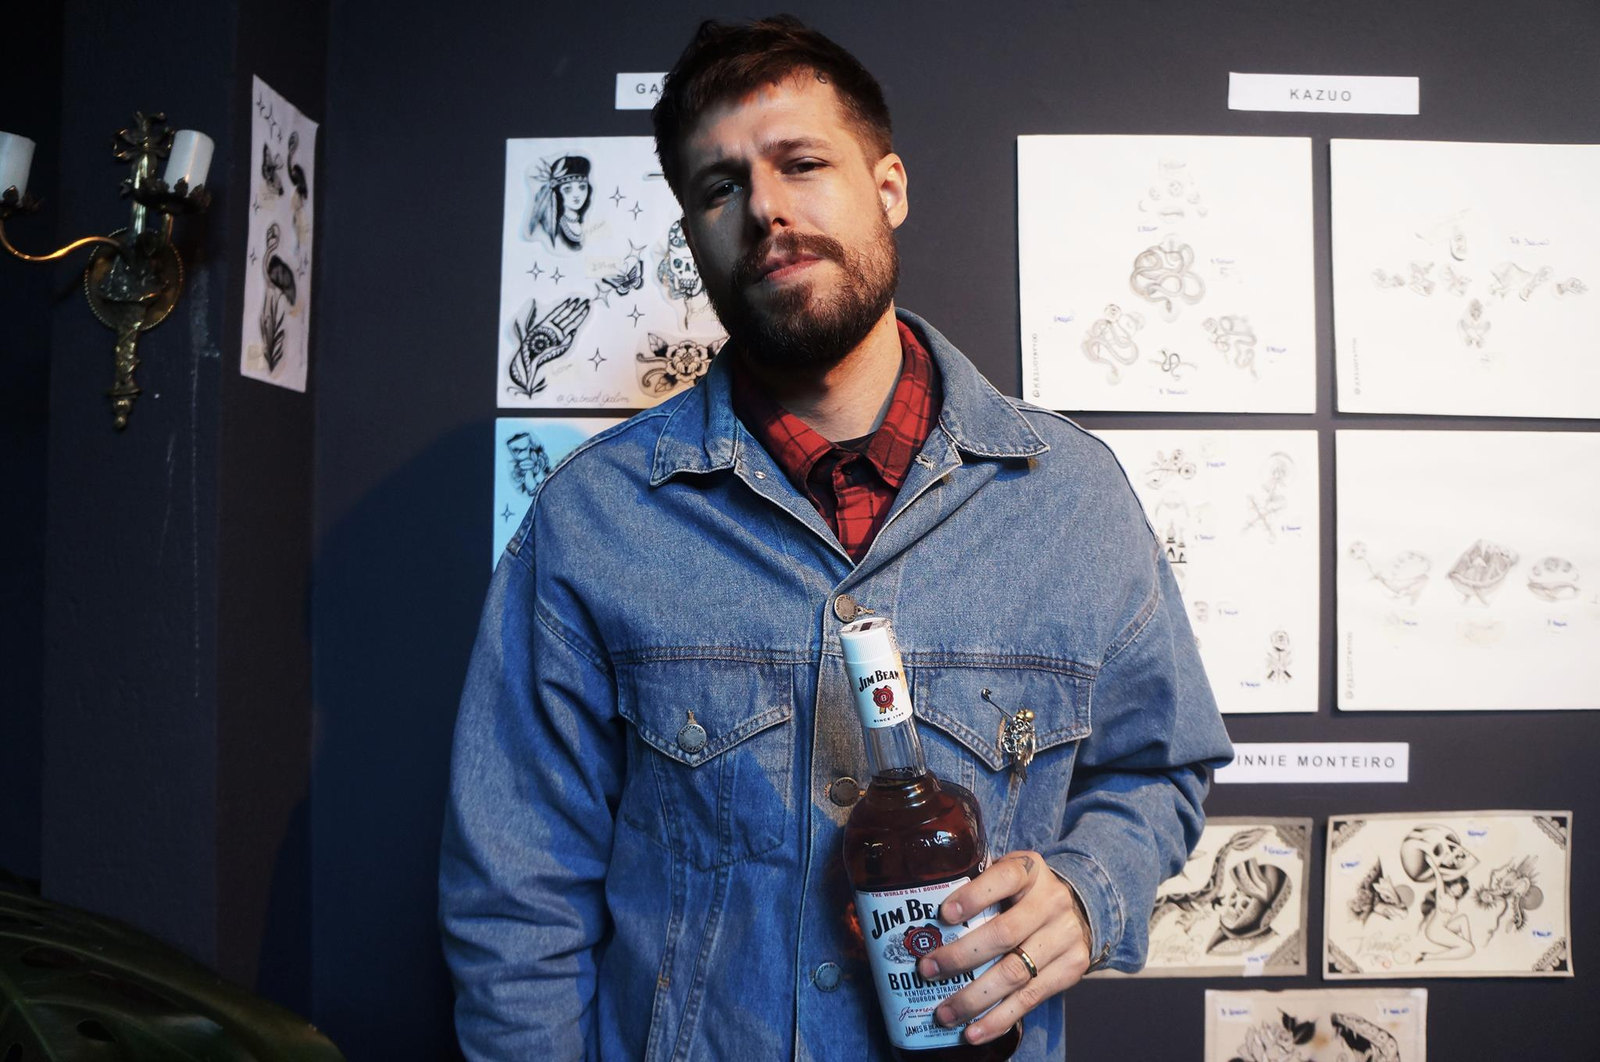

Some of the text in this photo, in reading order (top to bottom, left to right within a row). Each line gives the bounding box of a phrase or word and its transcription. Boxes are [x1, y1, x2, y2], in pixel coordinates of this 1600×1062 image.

[635, 83, 661, 95] GA
[1289, 88, 1352, 102] KAZUO
[859, 676, 875, 693] JIM
[1236, 754, 1396, 769] INNIE MONTEIRO
[884, 889, 909, 897] WORLD'S
[922, 882, 950, 892] BOURBON
[872, 907, 906, 940] JIM
[919, 937, 930, 949] B
[904, 984, 964, 997] KENTUCKY STRAIGHT
[908, 995, 936, 1004] BOURBON
[905, 1024, 923, 1037] JAMES
